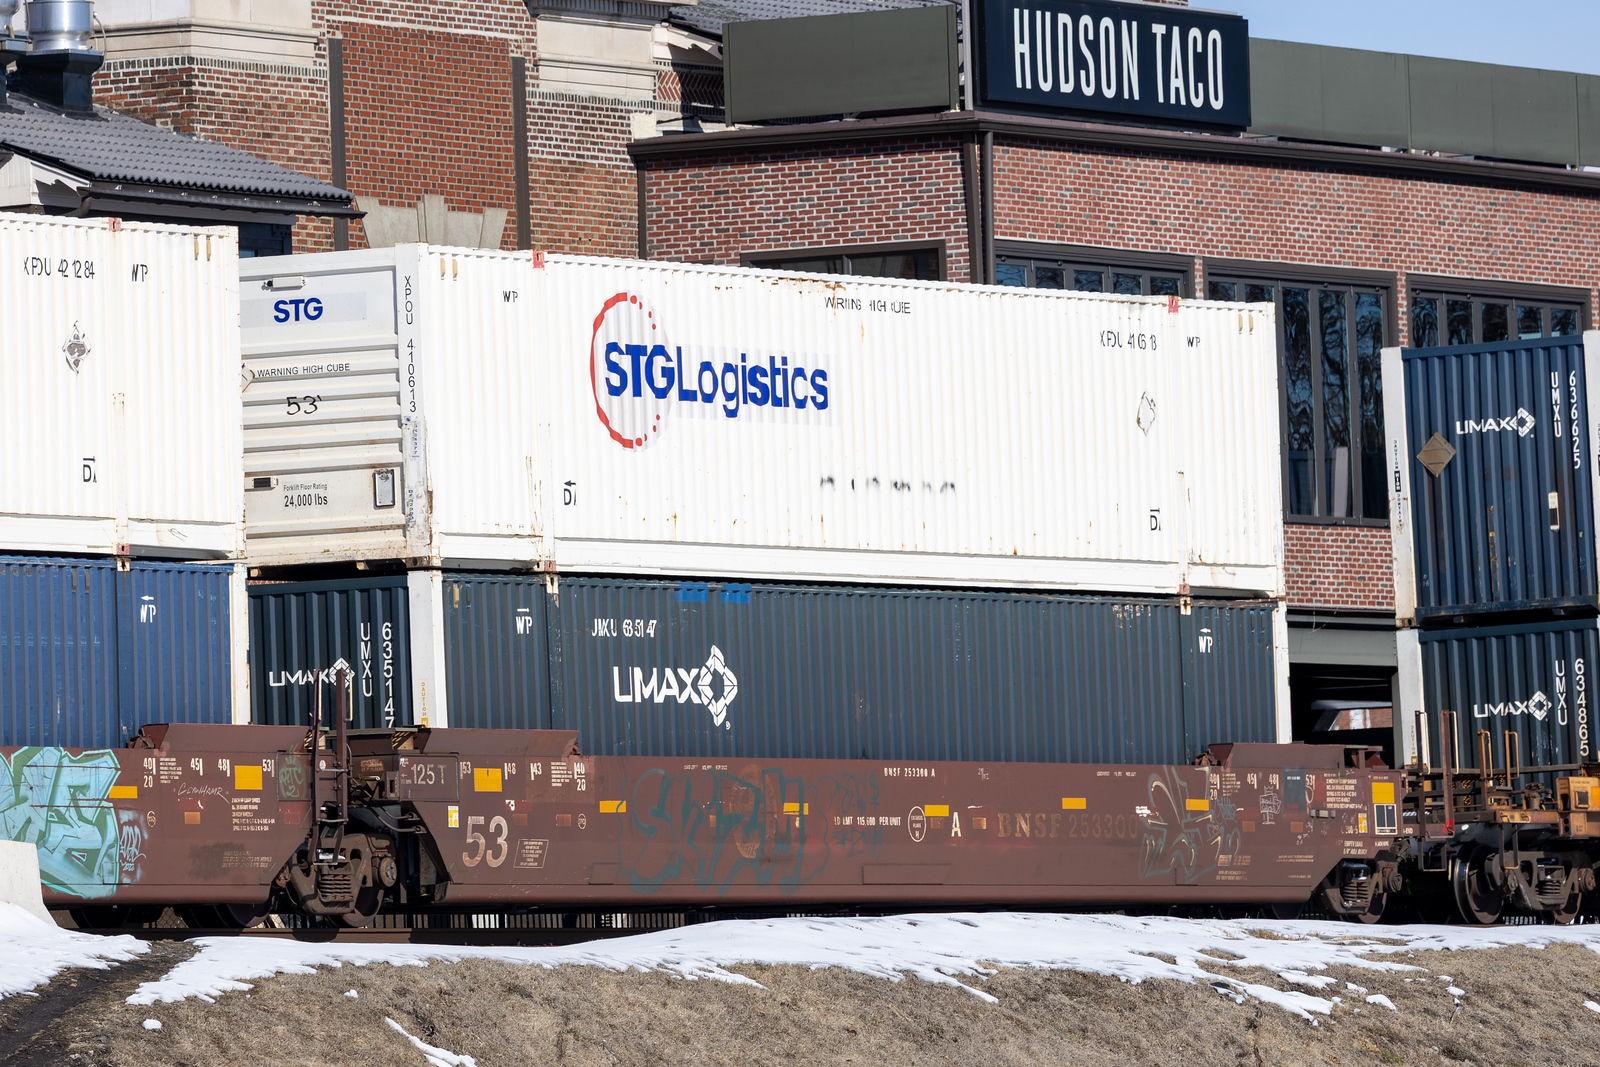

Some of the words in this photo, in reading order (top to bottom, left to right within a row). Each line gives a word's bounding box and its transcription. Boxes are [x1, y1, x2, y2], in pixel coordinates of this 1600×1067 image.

[1013, 8, 1140, 100] HUDSON
[1151, 23, 1224, 110] TACO
[404, 275, 414, 325] XPOU
[502, 290, 519, 303] WP
[273, 297, 324, 323] STG
[1186, 336, 1201, 348] WP
[257, 366, 299, 378] WARNING
[302, 364, 324, 374] HIGH
[326, 362, 350, 373] CUBE
[406, 338, 417, 413] 410613
[1550, 371, 1562, 438] UMXU
[1569, 370, 1581, 470] 636625
[283, 484, 300, 492] Forklift
[300, 483, 312, 491] Floor
[313, 483, 328, 492] Rating
[284, 494, 312, 508] 24,000
[314, 494, 328, 506] lbs
[515, 616, 533, 635] WP
[1198, 635, 1213, 654] WP
[360, 622, 373, 697] UMXU
[381, 622, 395, 728] 635147
[1555, 659, 1568, 726] UMXU
[1574, 658, 1589, 757] 634865
[190, 758, 200, 771] 45
[217, 758, 227, 772] 48
[262, 759, 272, 772] 53
[462, 761, 472, 774] 53
[507, 762, 517, 775] 48
[410, 763, 436, 785] 125
[883, 767, 901, 777] BNSF
[904, 768, 928, 778] 253300
[930, 768, 936, 778] A
[1246, 773, 1255, 785] 45
[1268, 773, 1277, 785] 48
[143, 775, 153, 788] 20
[577, 779, 586, 791] 20
[1305, 774, 1313, 786] 53
[1209, 789, 1218, 801] 20
[951, 812, 962, 838] A
[997, 812, 1063, 838] BNSF
[1068, 813, 1138, 839] 253300
[462, 815, 509, 868] 53
